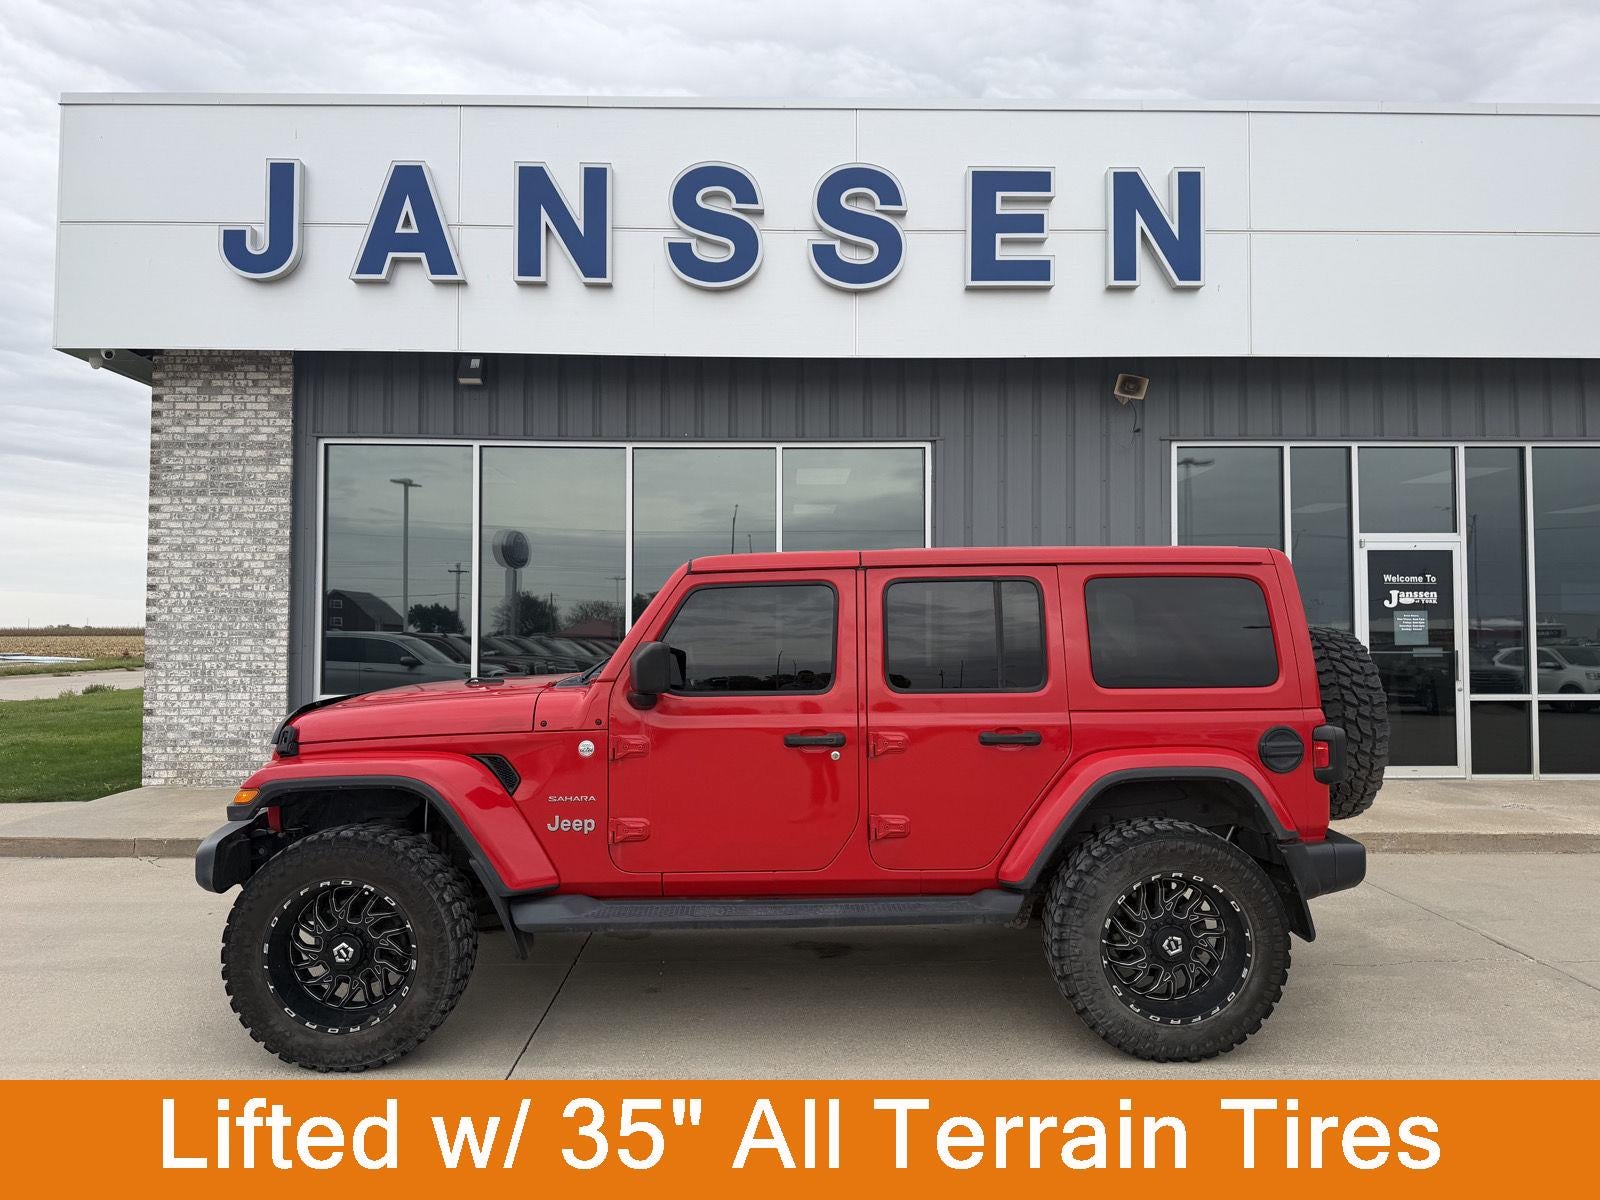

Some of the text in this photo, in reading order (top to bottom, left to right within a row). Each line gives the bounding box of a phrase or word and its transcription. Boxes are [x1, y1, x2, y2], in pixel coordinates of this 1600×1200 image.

[219, 159, 1206, 291] JANSSEN
[1383, 574, 1436, 582] Welcome To
[1383, 589, 1438, 608] Janssen
[546, 815, 596, 835] Jeep
